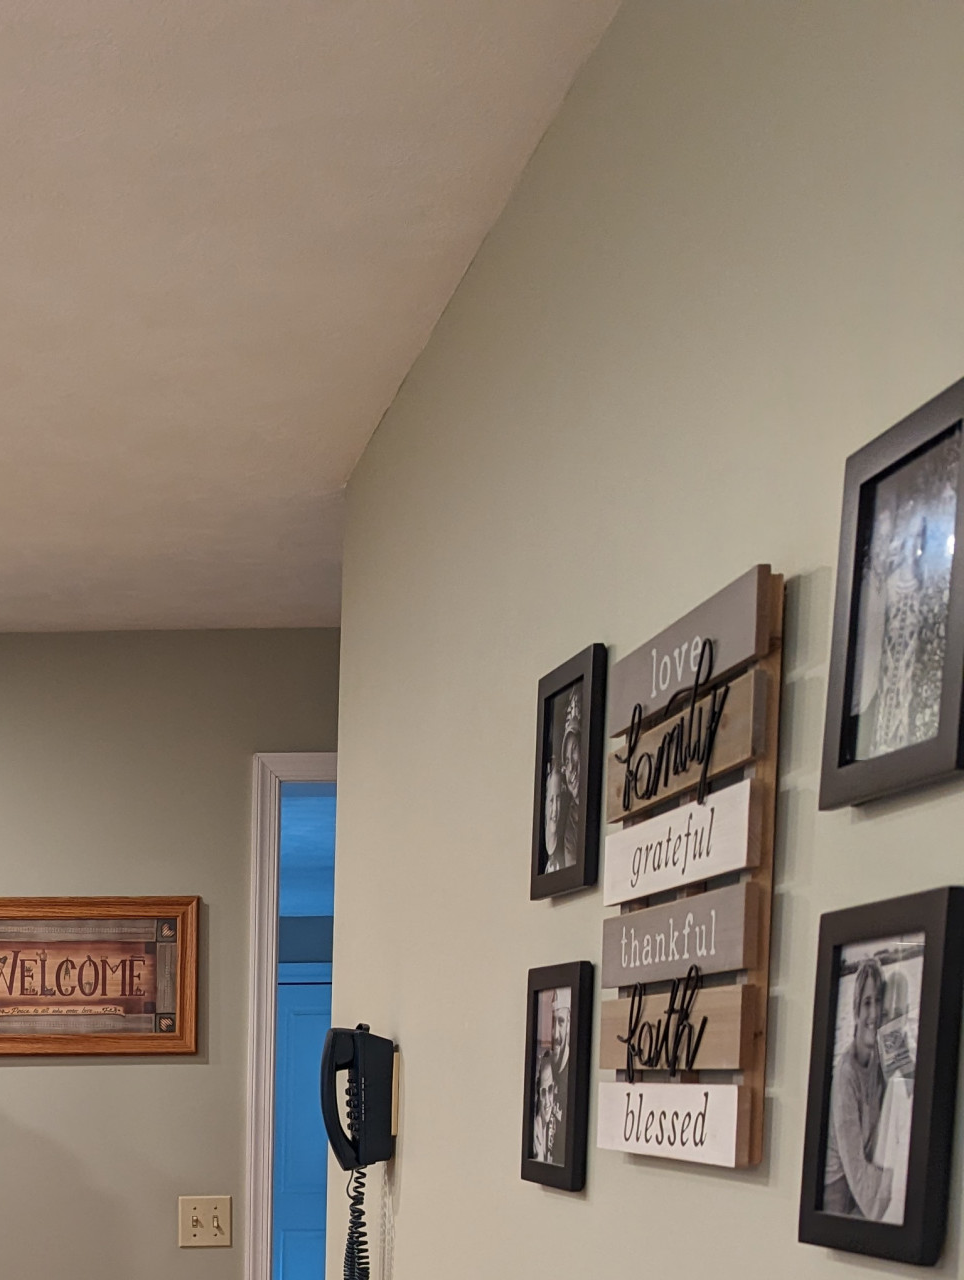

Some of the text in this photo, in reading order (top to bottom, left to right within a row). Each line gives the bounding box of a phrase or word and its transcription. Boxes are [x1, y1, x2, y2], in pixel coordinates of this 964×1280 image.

[651, 635, 703, 699] love
[614, 637, 731, 812] family
[630, 806, 716, 889] grateful
[620, 909, 717, 969] thankful
[616, 964, 709, 1084] faith
[623, 1091, 710, 1148] blessed
